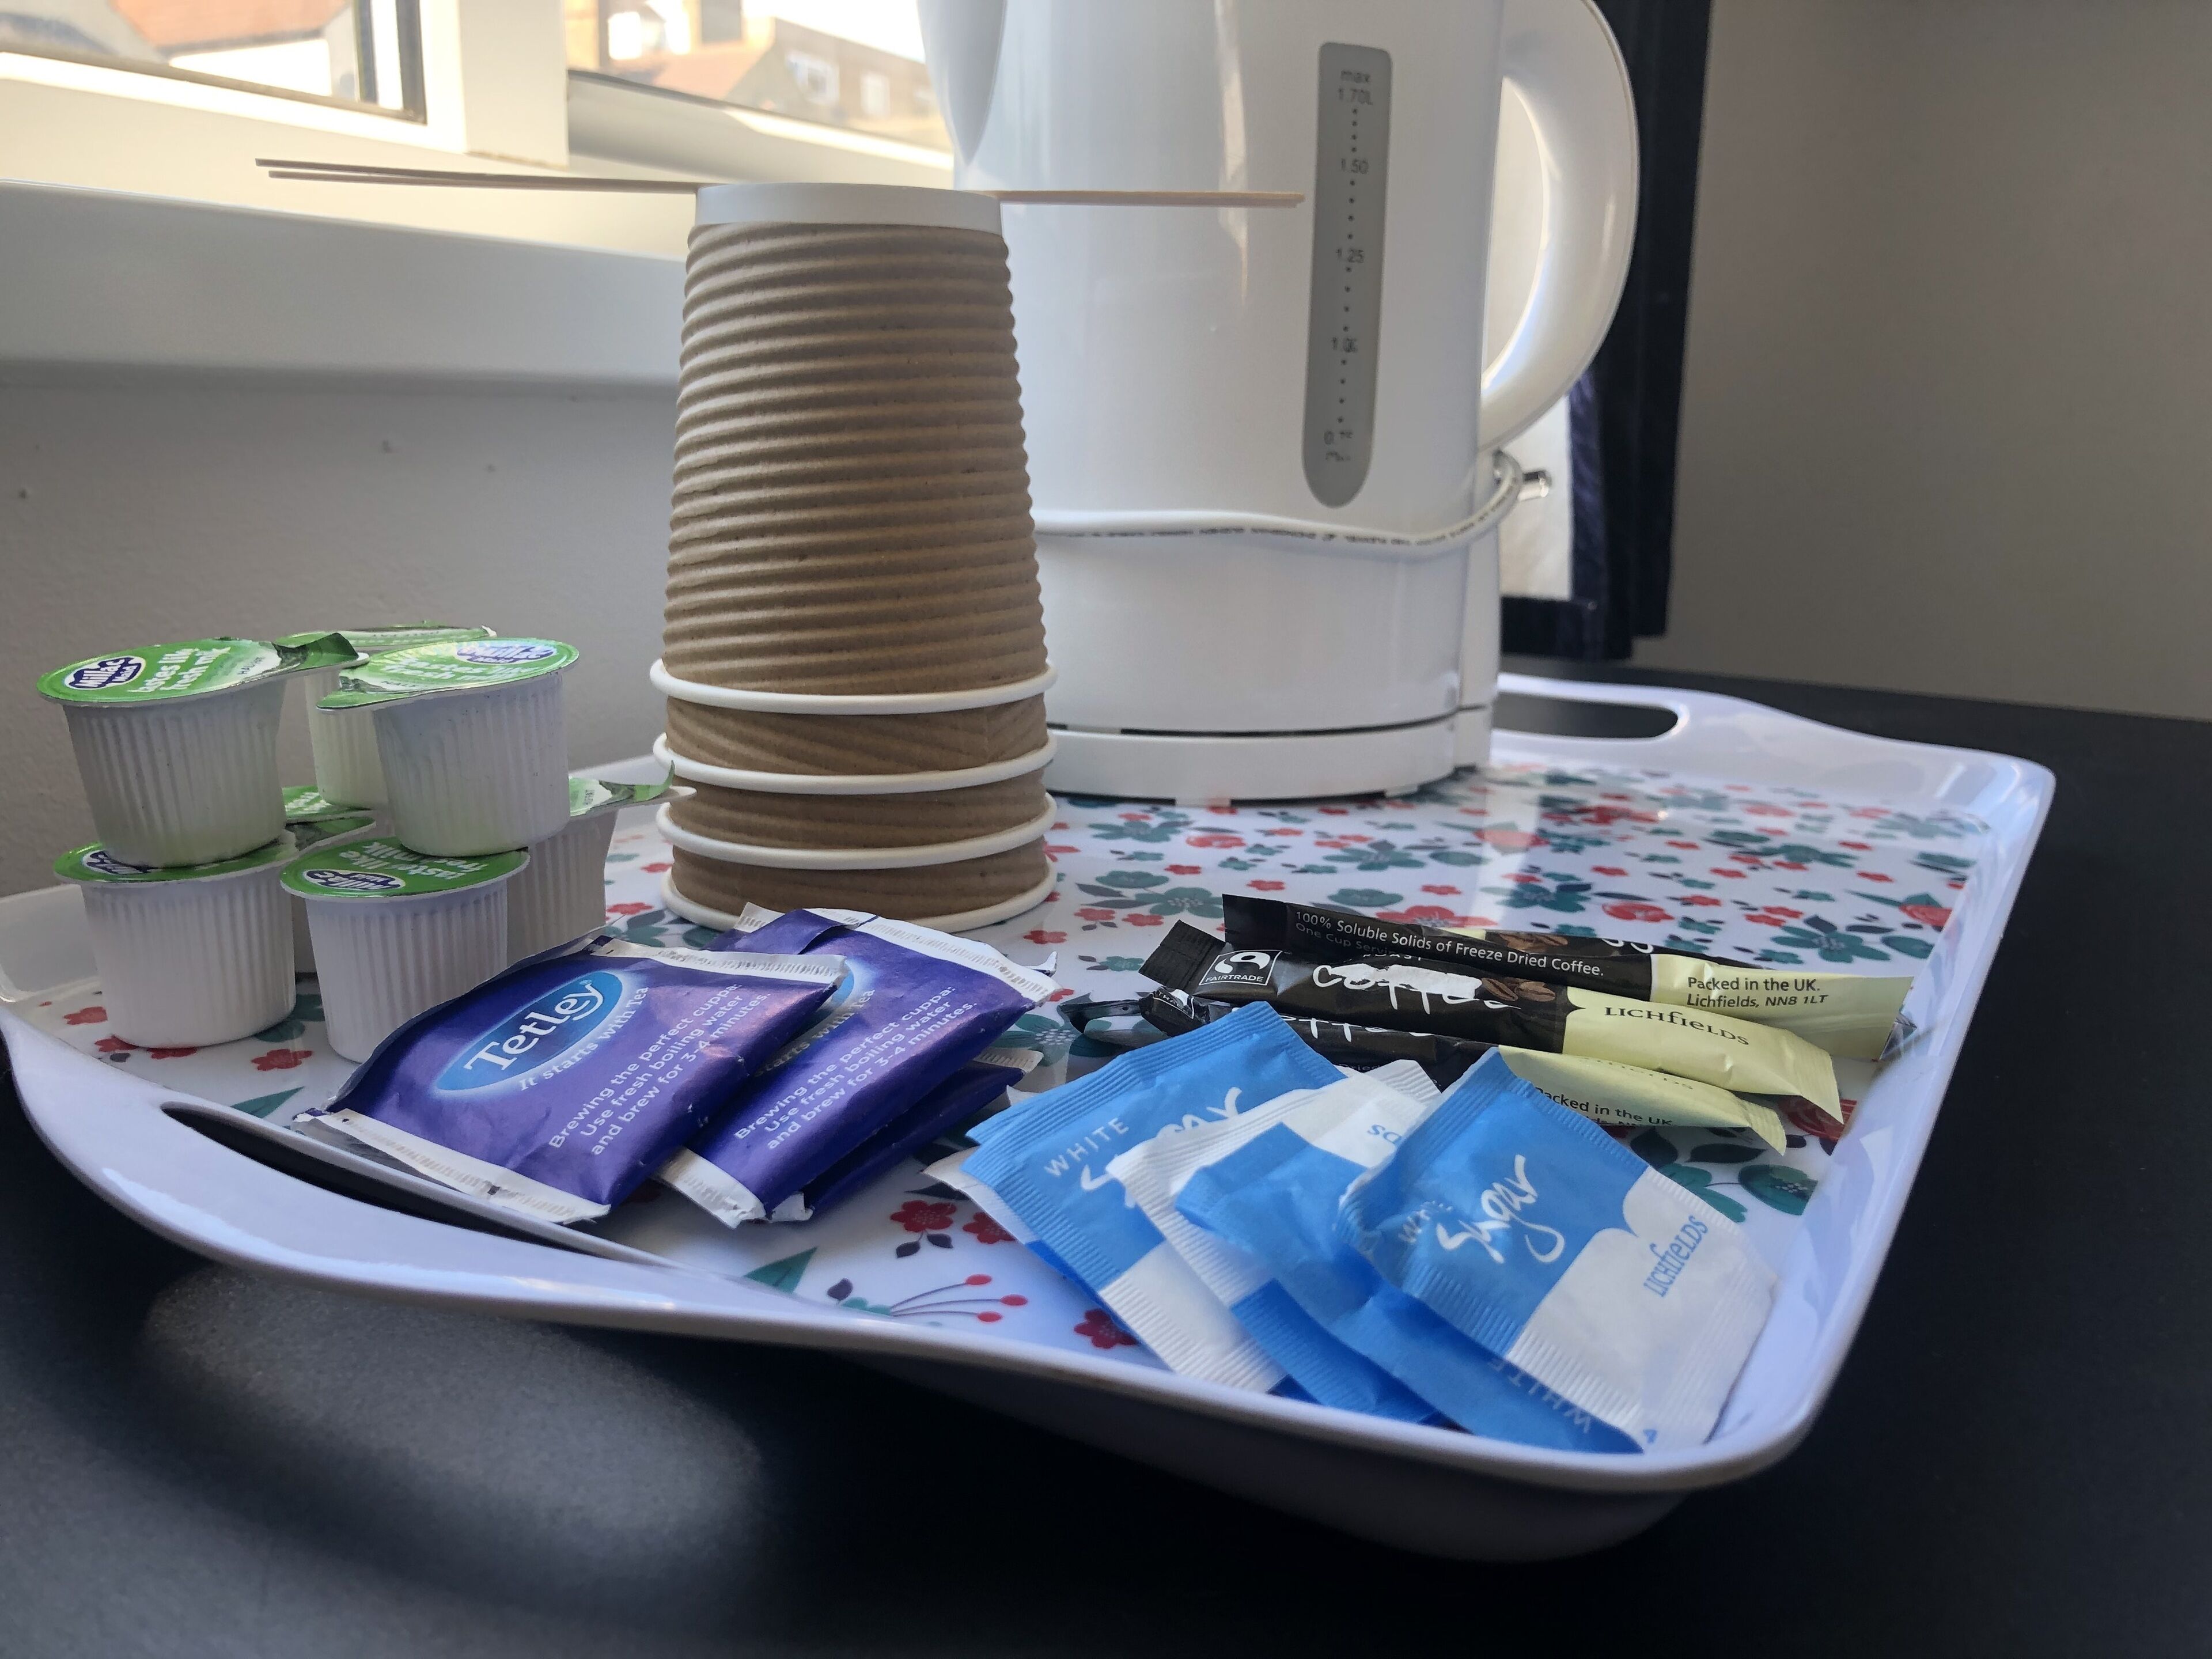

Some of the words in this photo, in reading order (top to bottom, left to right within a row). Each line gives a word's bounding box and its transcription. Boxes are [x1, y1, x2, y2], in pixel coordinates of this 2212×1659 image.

[75, 658, 125, 687] Millac
[313, 872, 391, 890] Millac
[1296, 923, 1321, 938] One
[1326, 933, 1351, 948] Cup
[1296, 911, 1331, 929] 100%
[1337, 920, 1388, 942] Soluble
[1392, 932, 1431, 950] Solids
[1436, 940, 1452, 952] of
[1456, 942, 1503, 961] Freeze
[1507, 951, 1547, 968] Dried
[1551, 959, 1604, 976] Coffee.
[1205, 974, 1264, 982] FAIRTRADE
[1687, 994, 1759, 1008] Lichfields,
[1765, 996, 1797, 1006] NN8
[1803, 994, 1829, 1005] 1LT
[1688, 976, 1739, 991] Packed
[1745, 978, 1758, 991] in
[1763, 978, 1789, 991] the
[1794, 979, 1820, 991] UK.
[464, 981, 604, 1071] Tetley
[518, 1078, 537, 1092] It
[544, 1041, 599, 1081] starts
[598, 1009, 636, 1040] with
[627, 987, 649, 1011] Tea
[734, 1086, 808, 1139] Brewing
[807, 1064, 838, 1085] the
[839, 1021, 900, 1063] perfect
[902, 986, 956, 1021] cuppa:
[548, 1087, 615, 1149] Brewing
[611, 1062, 641, 1085] the
[638, 1017, 694, 1061] perfect
[693, 984, 743, 1017] cuppa:
[580, 1109, 614, 1136] Use
[611, 1072, 653, 1107] fresh
[649, 1028, 705, 1070] boiling
[702, 995, 744, 1027] water
[591, 1124, 623, 1156] and
[618, 1086, 660, 1123] brew
[658, 1064, 684, 1085] for
[681, 1040, 711, 1063] 3-4
[710, 994, 772, 1039] minutes.
[764, 1107, 800, 1132] Use
[800, 1074, 846, 1105] fresh
[844, 1033, 906, 1073] boiling
[906, 1001, 952, 1032] water
[767, 1121, 802, 1150] and
[801, 1088, 846, 1122] brew
[847, 1068, 874, 1086] for
[874, 1046, 907, 1067] 3-4
[908, 1002, 978, 1046] minutes.
[1044, 1118, 1130, 1178] WHITE
[1595, 1104, 1609, 1115] in
[1615, 1109, 1643, 1122] the
[1435, 1153, 1565, 1264] Sugar
